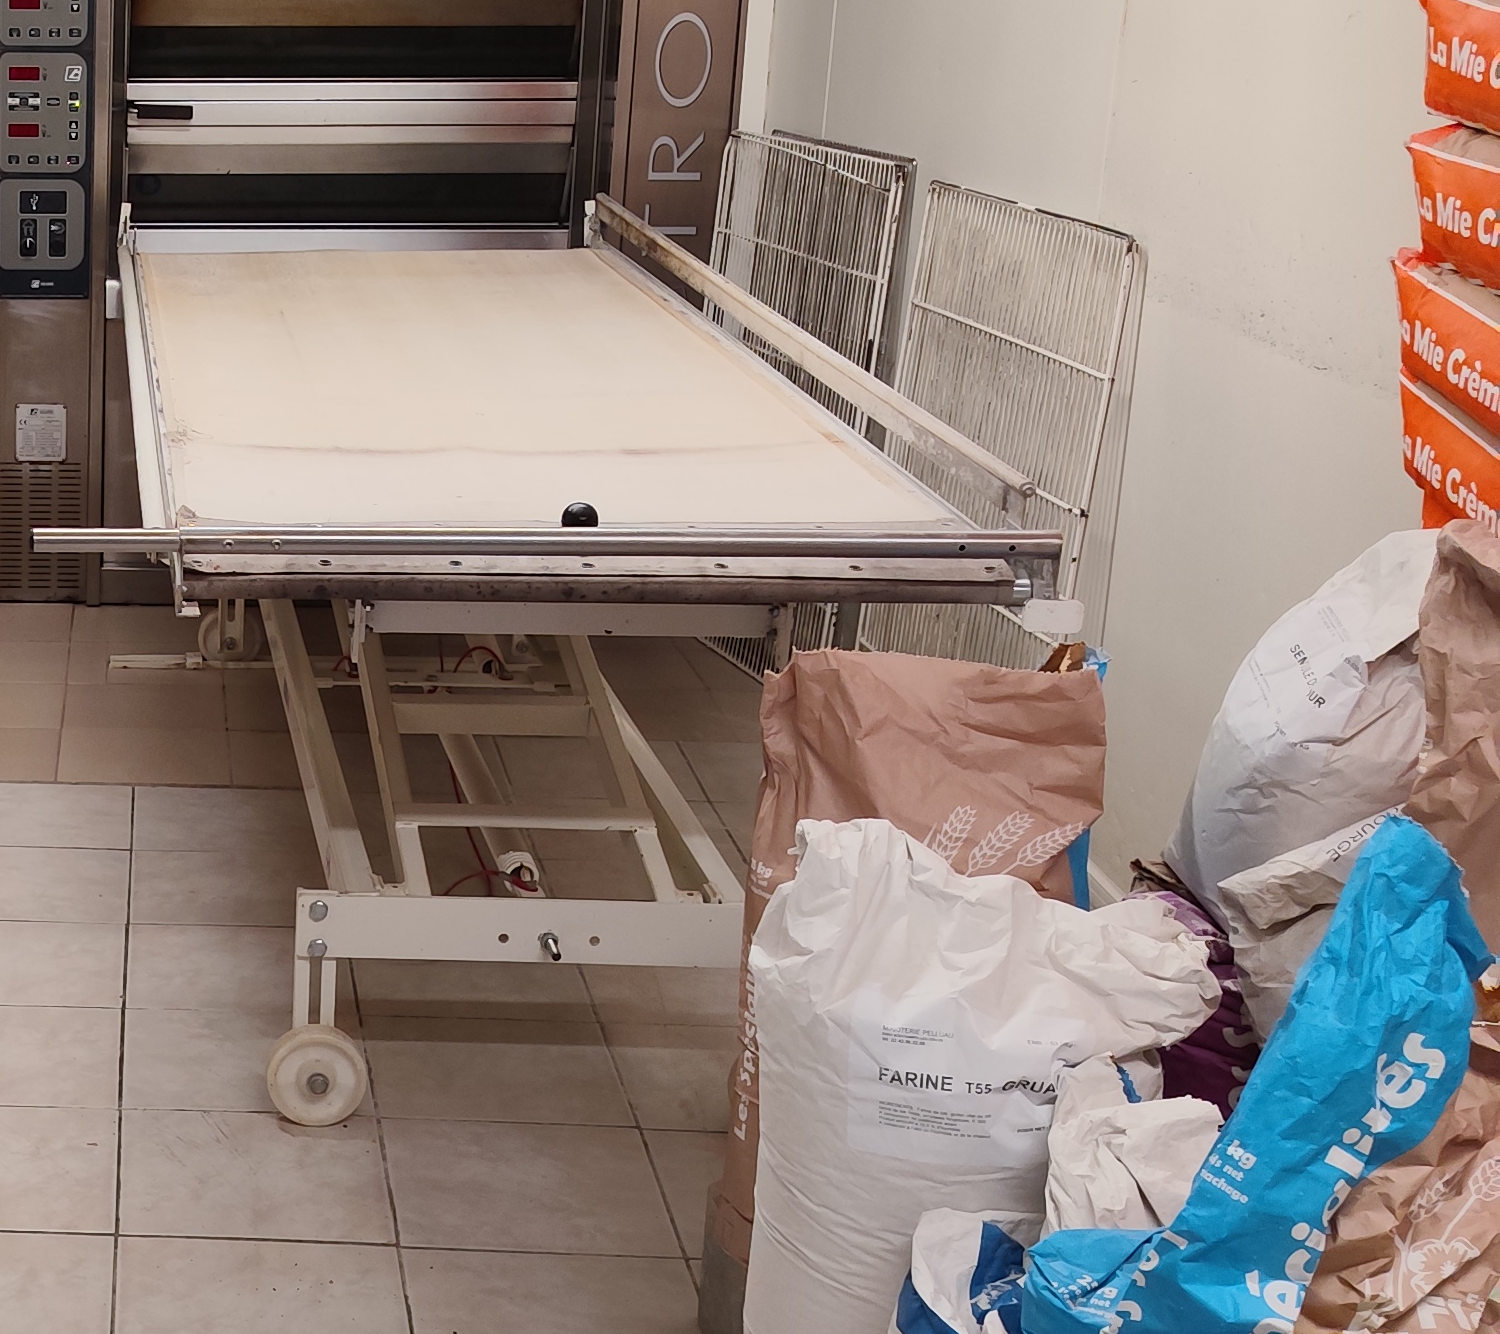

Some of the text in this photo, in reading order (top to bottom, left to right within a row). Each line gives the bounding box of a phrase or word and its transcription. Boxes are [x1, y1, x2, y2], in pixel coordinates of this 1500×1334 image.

[1429, 26, 1448, 68] La
[1450, 36, 1486, 83] Mie
[1435, 192, 1473, 238] Mie
[1412, 319, 1444, 372] Mie
[1446, 348, 1500, 416] Crèm
[1413, 436, 1442, 490] Mie
[1445, 467, 1500, 537] Crèm
[878, 1066, 954, 1093] FARINE
[965, 1081, 993, 1095] T55
[1225, 1139, 1258, 1170] kg
